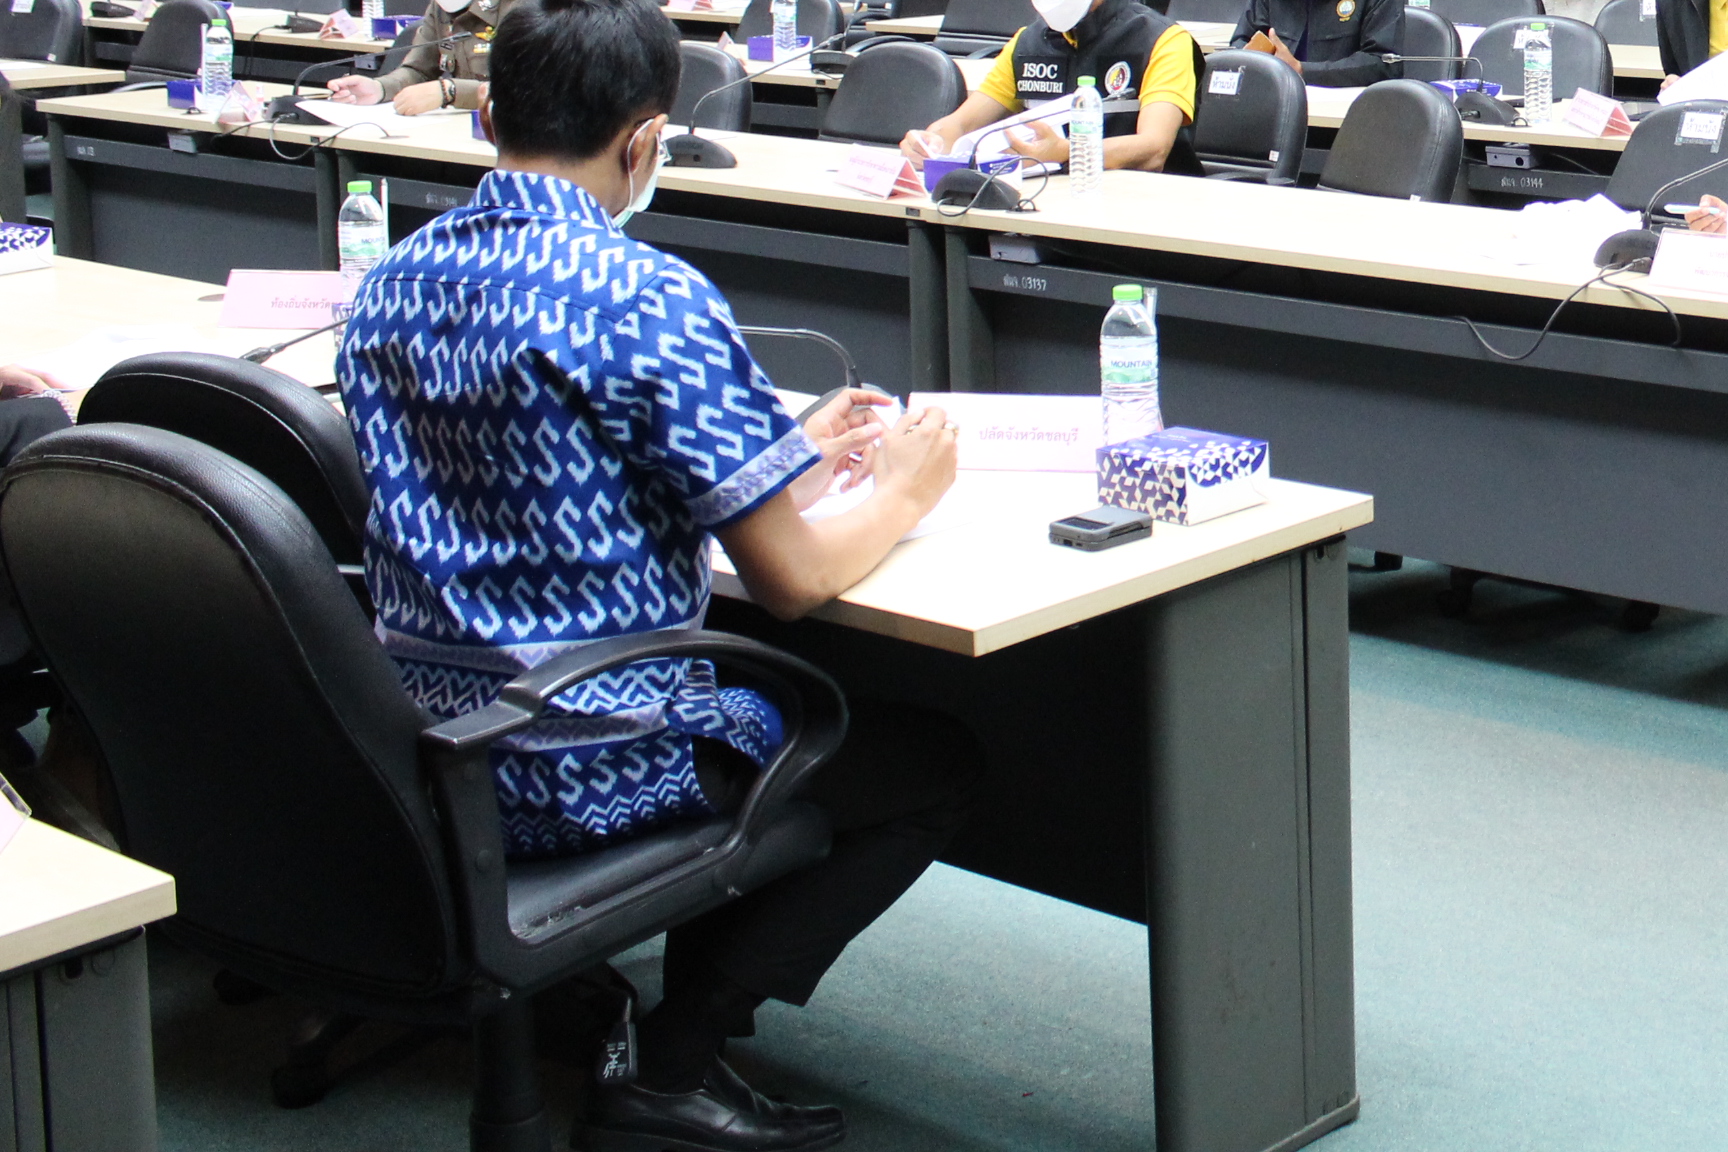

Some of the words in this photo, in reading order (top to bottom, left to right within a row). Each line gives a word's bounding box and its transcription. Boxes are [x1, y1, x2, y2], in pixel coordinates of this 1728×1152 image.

[1022, 62, 1059, 79] ISOC
[1017, 80, 1064, 94] CHONBURI
[1021, 276, 1047, 291] 03137
[271, 294, 333, 309] ท้องถิ่นจังหวัด
[979, 426, 1079, 446] ปลัดจังหวัดชลบุรี
